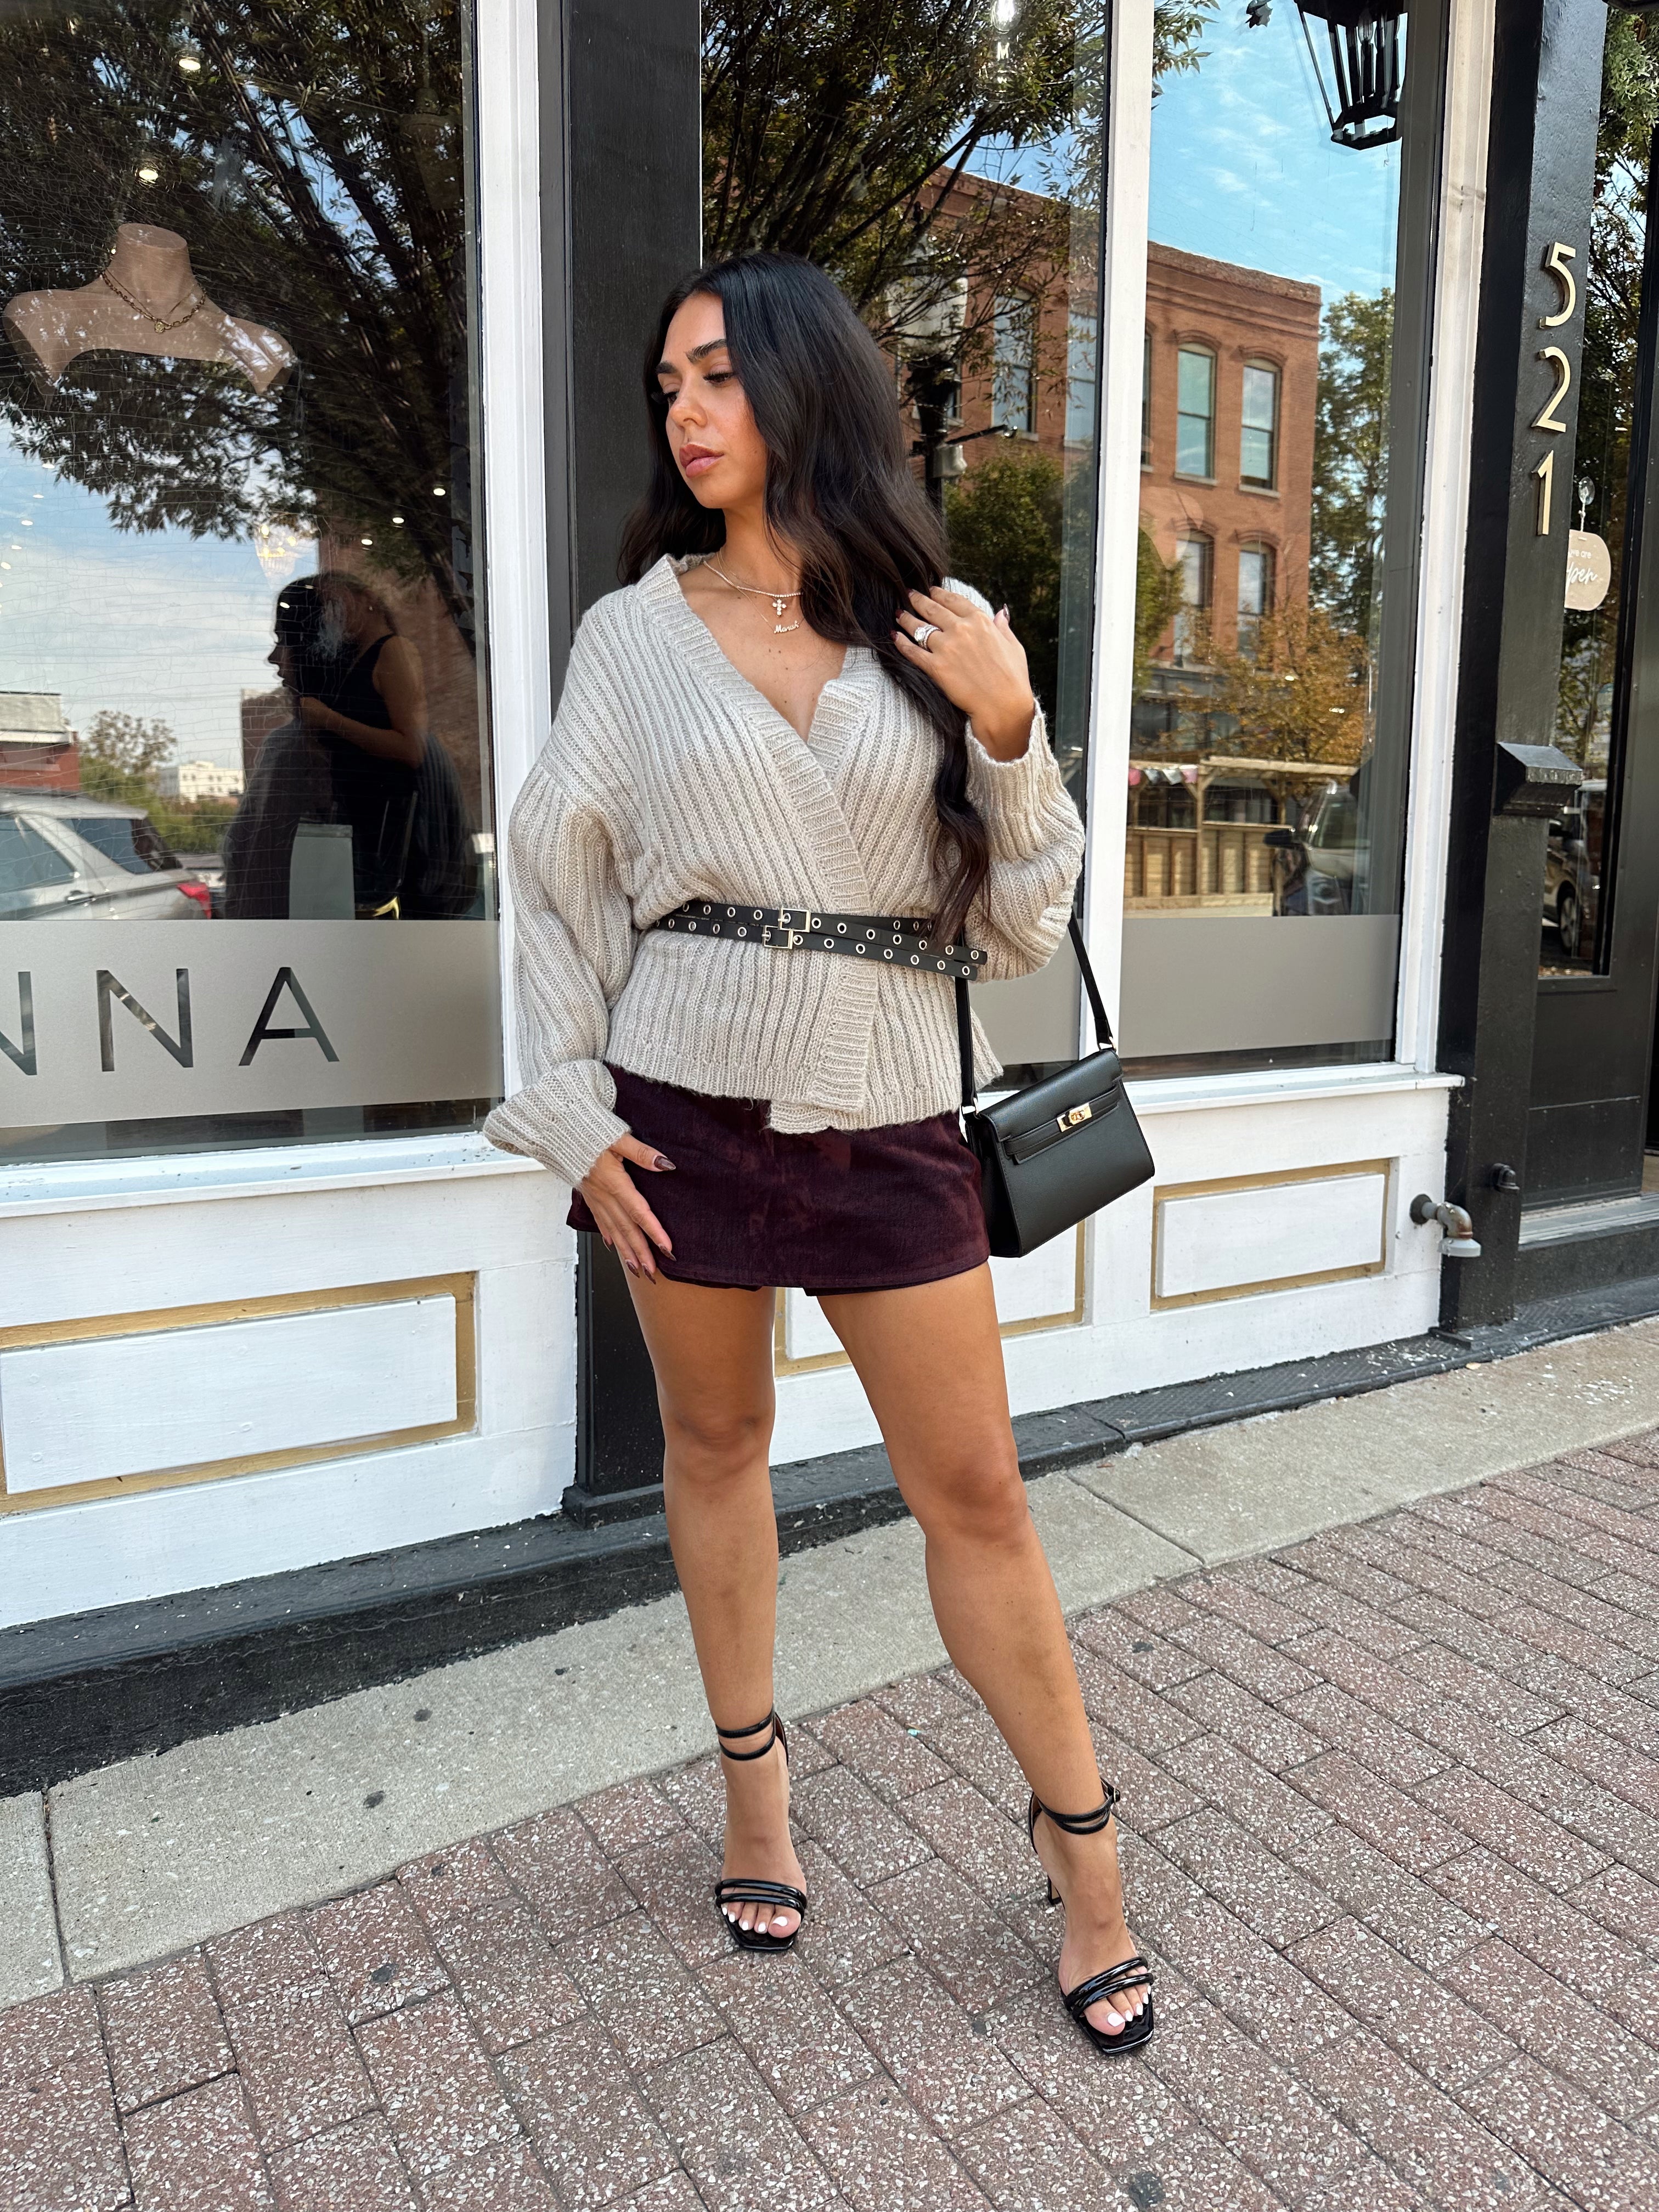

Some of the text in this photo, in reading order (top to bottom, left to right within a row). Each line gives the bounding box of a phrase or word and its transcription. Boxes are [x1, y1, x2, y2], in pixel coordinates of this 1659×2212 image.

[1532, 241, 1576, 536] 521
[1581, 550, 1592, 559] are
[1565, 561, 1598, 595] pen
